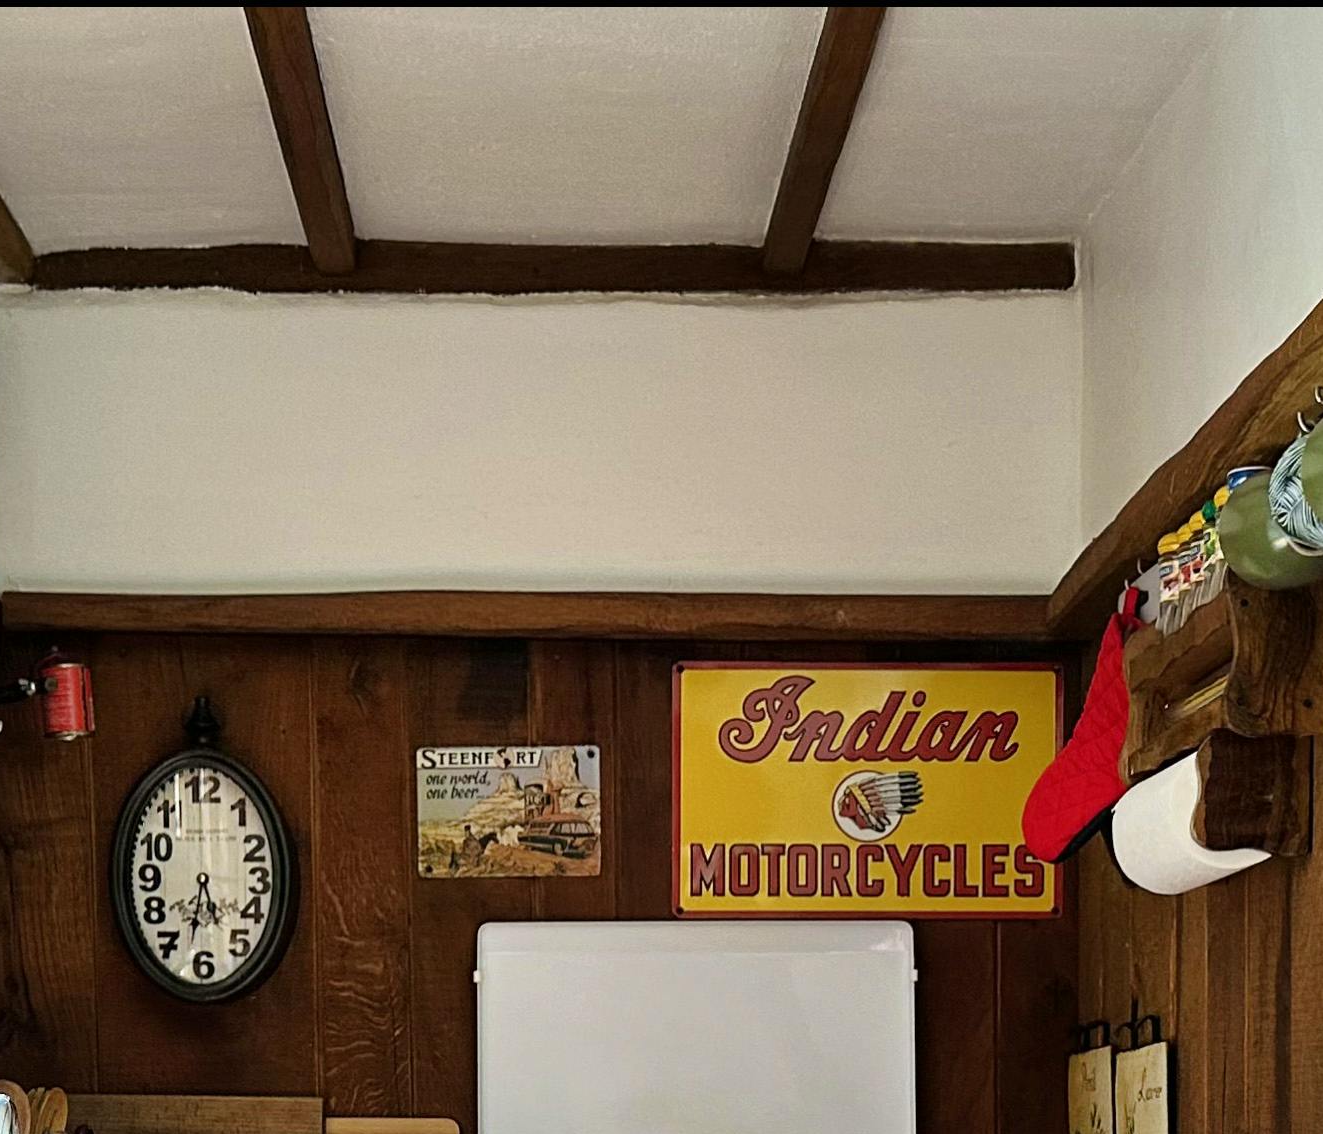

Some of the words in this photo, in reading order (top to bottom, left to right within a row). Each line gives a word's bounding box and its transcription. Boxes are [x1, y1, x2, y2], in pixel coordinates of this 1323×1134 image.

[718, 675, 1019, 763] Indian
[184, 775, 221, 803] 12
[426, 775, 448, 785] one
[450, 772, 491, 787] world,
[426, 789, 448, 799] one
[157, 800, 182, 828] 11
[230, 798, 247, 827] 1
[140, 833, 173, 862] 10
[243, 834, 266, 862] 2
[138, 864, 161, 892] 9
[248, 867, 271, 895] 3
[690, 843, 1045, 898] MOTORCYCLES
[143, 896, 166, 924] 8
[240, 896, 264, 924] 4
[157, 931, 180, 959] 7
[229, 929, 251, 957] 5
[192, 951, 215, 979] 6
